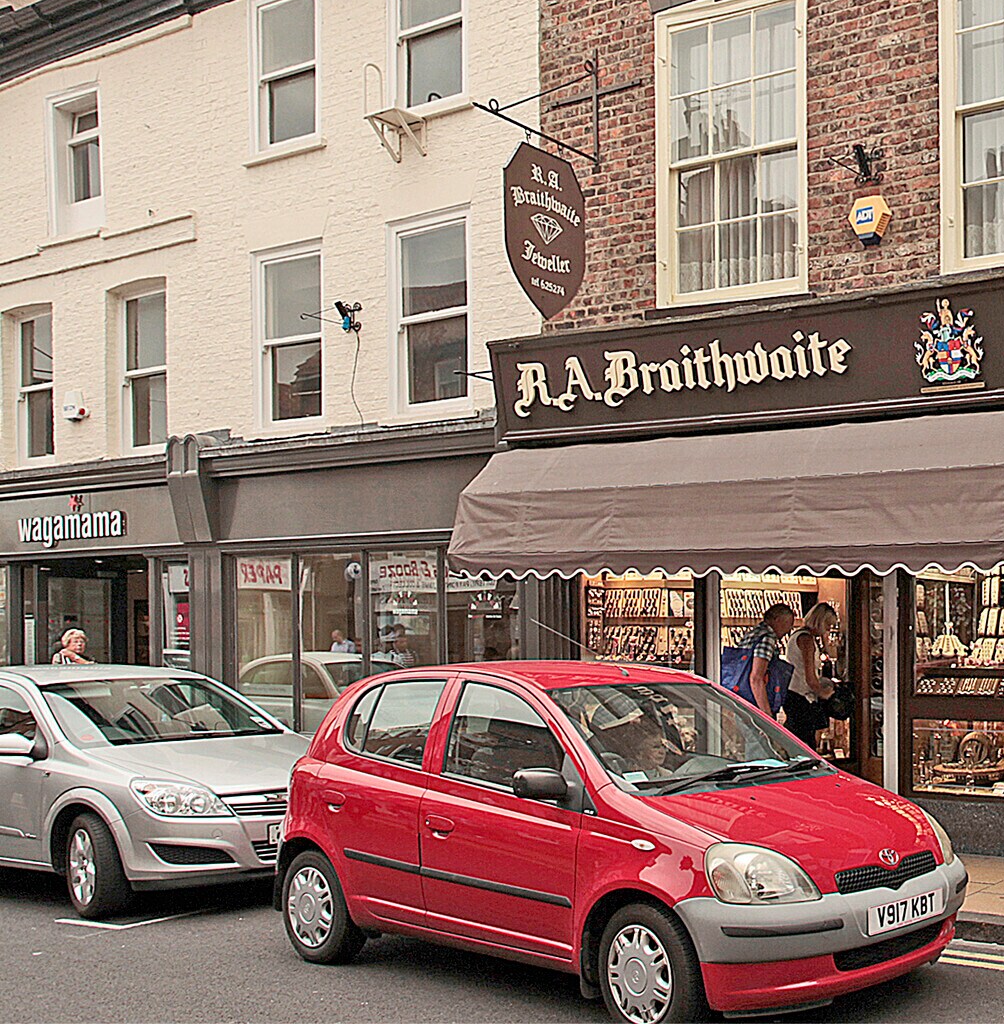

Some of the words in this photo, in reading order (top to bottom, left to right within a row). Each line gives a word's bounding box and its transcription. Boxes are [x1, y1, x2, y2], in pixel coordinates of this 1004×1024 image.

[510, 185, 581, 227] Braithwaite
[857, 209, 873, 222] ADT
[521, 239, 571, 273] Jeweller
[540, 279, 566, 297] 625274
[18, 511, 122, 548] wagamama
[877, 900, 908, 927] V917
[911, 892, 935, 918] KBT
